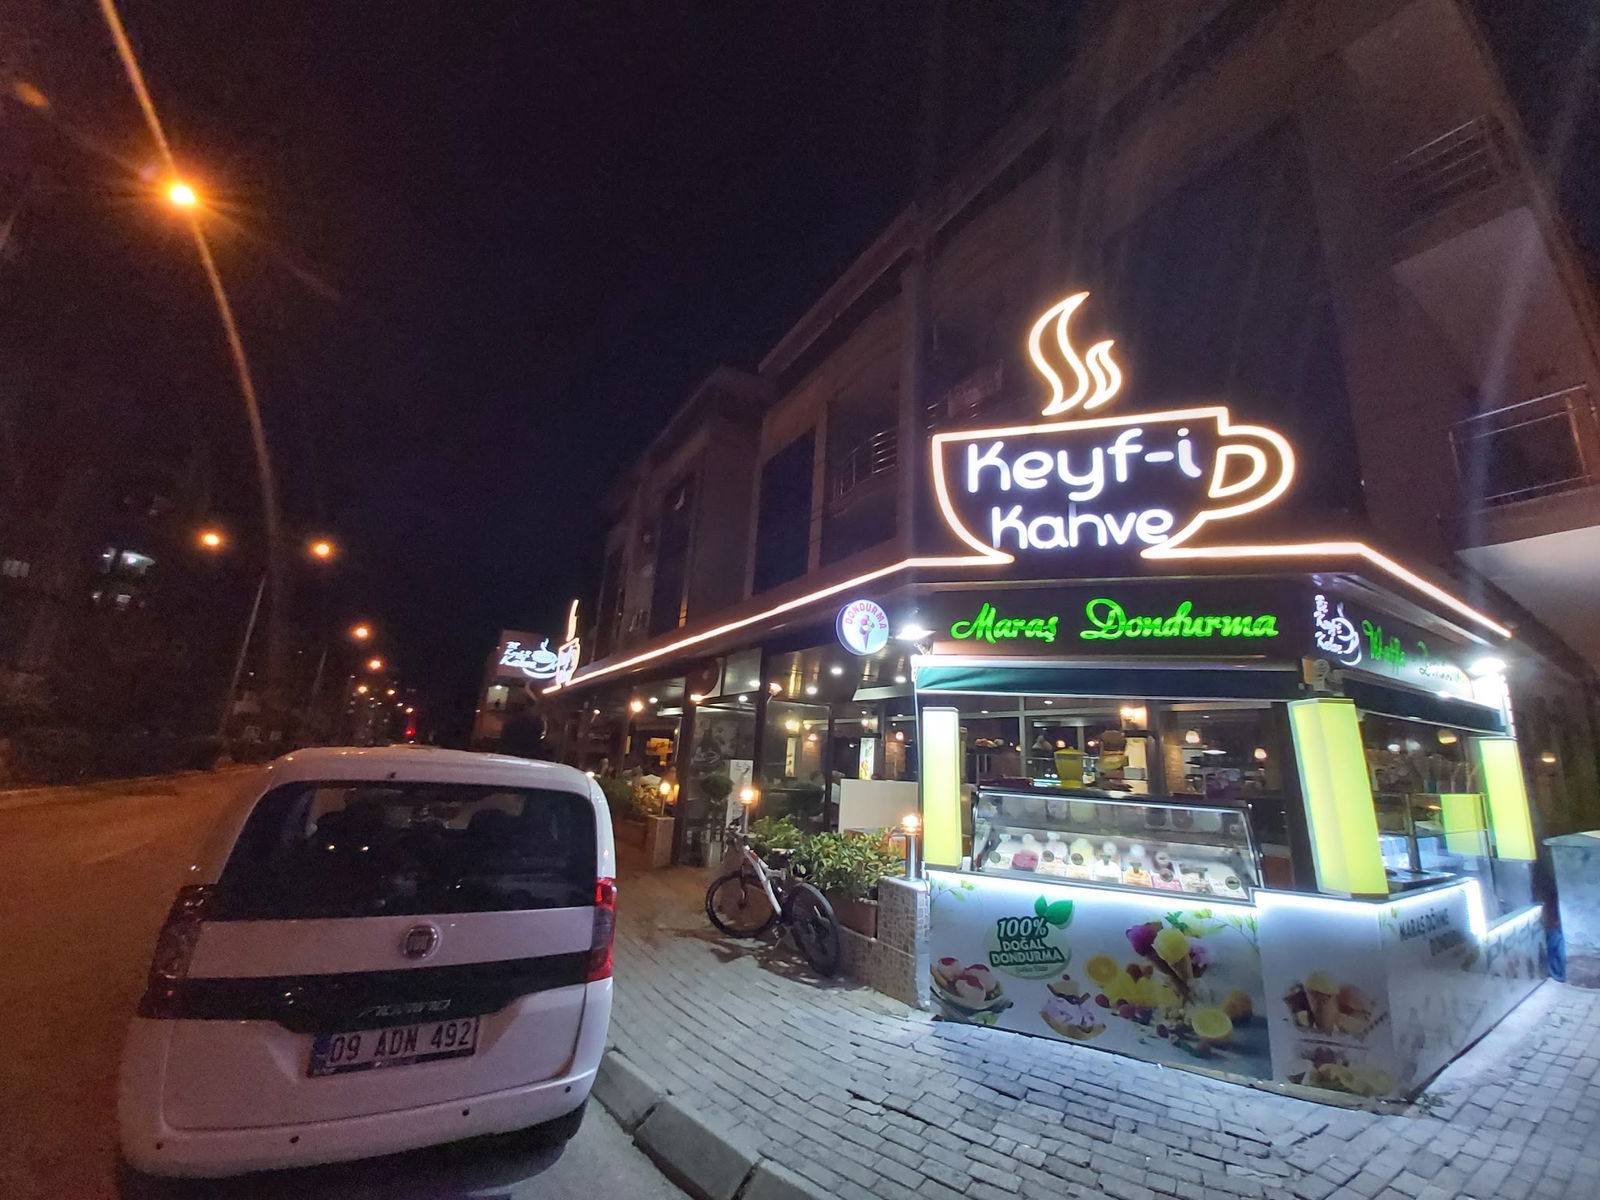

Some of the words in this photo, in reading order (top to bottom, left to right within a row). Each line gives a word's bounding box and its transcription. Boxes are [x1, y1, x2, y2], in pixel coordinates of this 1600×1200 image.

[966, 427, 1202, 501] Keyf-i
[991, 502, 1175, 550] Kahve
[845, 602, 888, 630] DONDURMA
[950, 602, 1059, 643] Maraş
[1080, 598, 1280, 641] Dondurma
[998, 917, 1048, 938] 100%
[1002, 937, 1045, 952] DOĞAL
[990, 948, 1064, 965] DONDURMA
[330, 1035, 362, 1064] 09
[373, 1027, 420, 1057] ADN
[430, 1021, 472, 1049] 492
